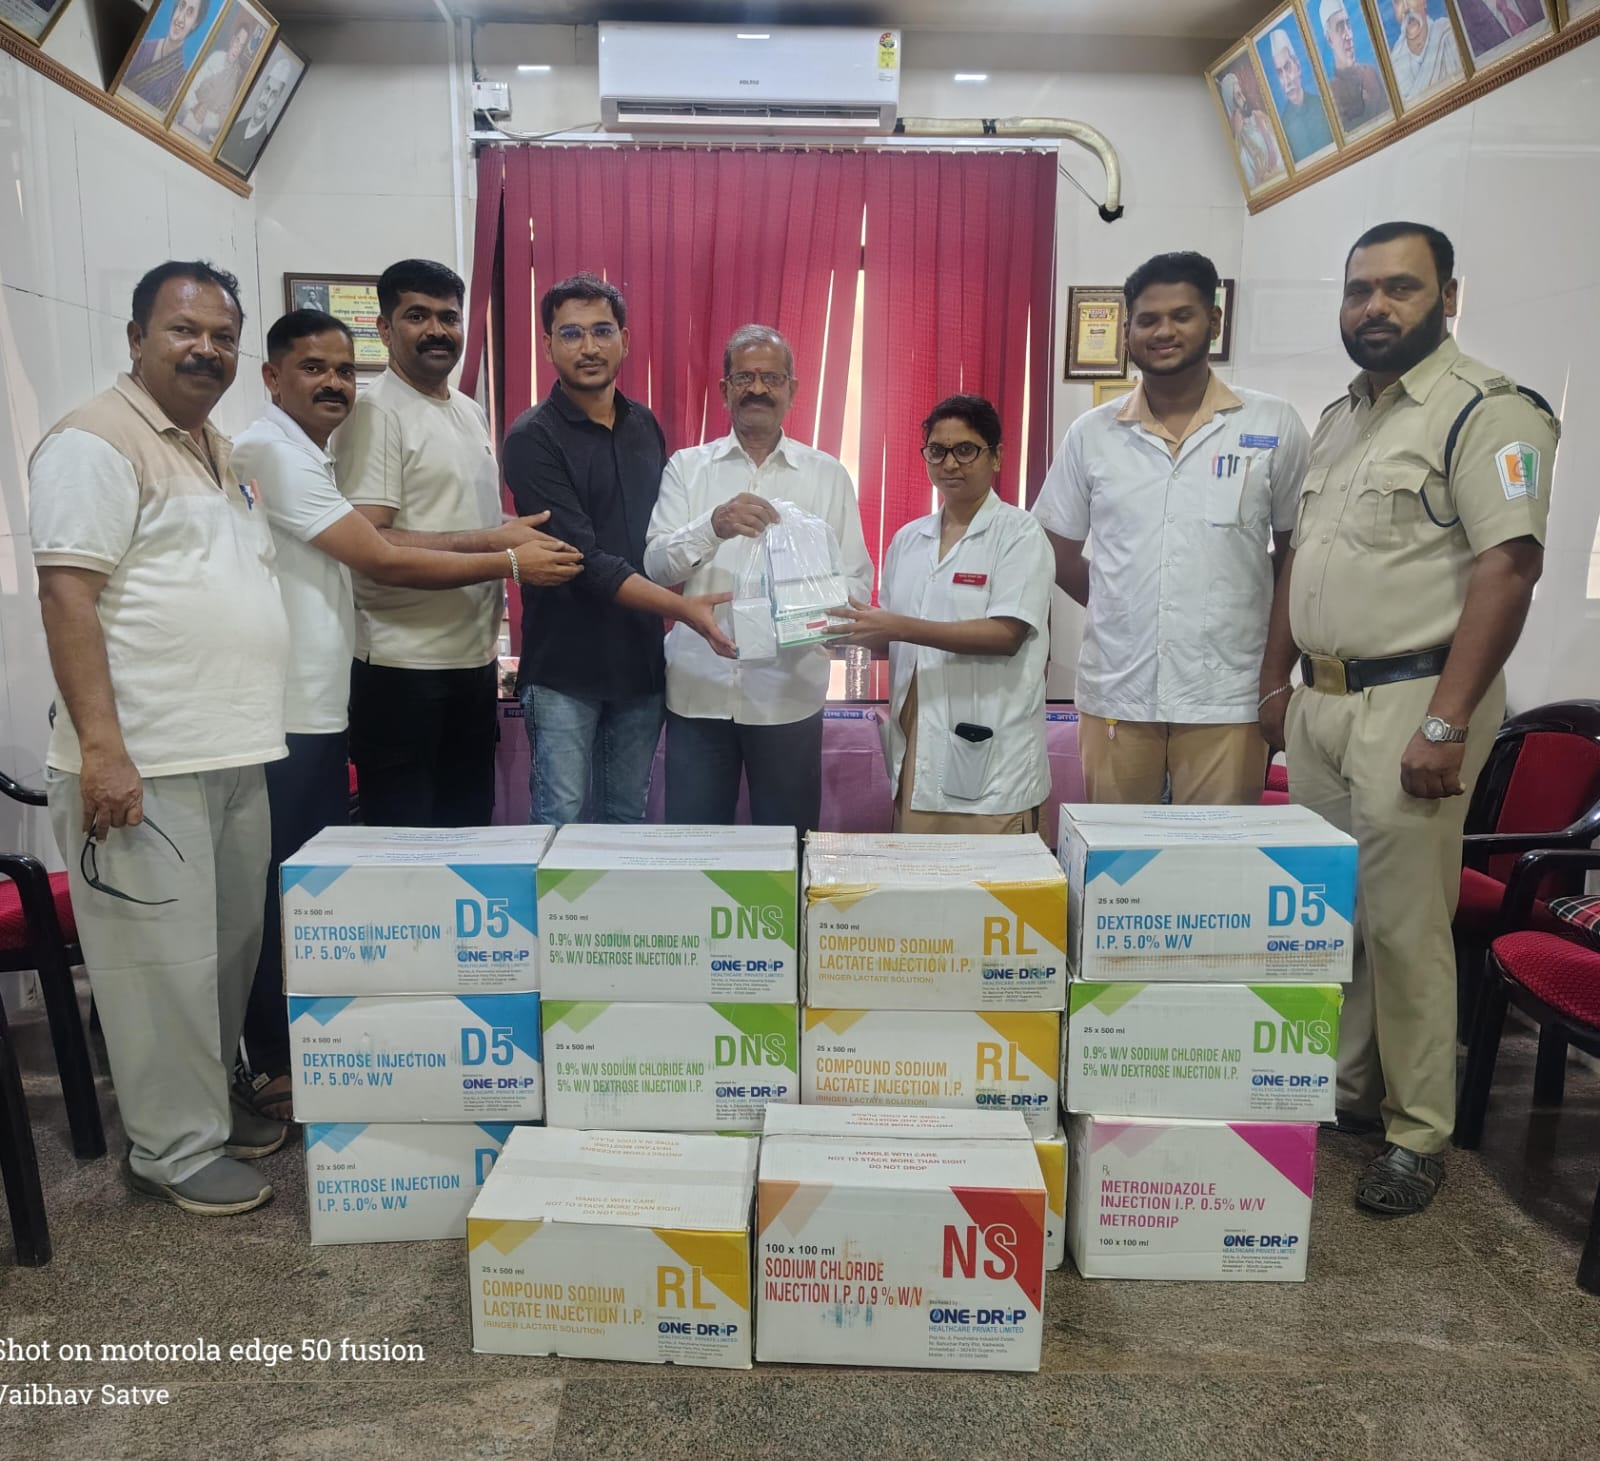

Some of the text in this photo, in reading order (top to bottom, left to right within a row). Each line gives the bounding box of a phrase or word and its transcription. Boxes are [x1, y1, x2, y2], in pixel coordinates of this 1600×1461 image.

[1268, 885, 1325, 927] D5
[456, 898, 510, 938] D5
[711, 905, 784, 940] DNS
[1097, 914, 1250, 930] DEXTROSE INJECTION
[295, 925, 440, 941] DEXTROSE INJECTION
[550, 933, 699, 948] 0.9% W/V SODIUM CHLORIDE AND
[983, 916, 1038, 956] RL
[1097, 934, 1193, 949] I.P. 5.0% W/V
[296, 945, 386, 960] I.P. 5.0% W/V
[819, 936, 954, 954] COMPOUND SODIUM
[550, 951, 698, 966] 5% W/V DEXTROSE INJECTION I.P.
[819, 955, 971, 973] LACTATE INJECTION I.P.
[461, 1027, 514, 1066] D5
[1254, 1020, 1331, 1056] DNS
[715, 1033, 786, 1067] DNS
[1084, 1047, 1241, 1062] 0.9% W/V SODIUM CHLORIDE AND
[303, 1053, 446, 1067] DEXTROSE INJECTION
[817, 1058, 947, 1077] COMPOUND SODIUM
[977, 1042, 1029, 1081] RL
[557, 1063, 704, 1076] 0.9% W/V SODIUM CHLORIDE AND
[1083, 1064, 1239, 1080] 5% W/V DEXTROSE INJECTION I.P.
[304, 1072, 393, 1087] I.P. 5.0% W/V
[558, 1079, 703, 1093] 5% W/V DEXTROSE INJECTION I.P.
[816, 1077, 964, 1097] LACTATE INJECTION I.P.
[318, 1175, 460, 1194] DEXTROSE INJECTION
[1102, 1180, 1216, 1196] METRONIDAZOLE
[318, 1195, 408, 1212] I.P. 5.0% W/V
[1101, 1196, 1266, 1211] INJECTION I.P. 0.5% W/V
[1100, 1215, 1179, 1228] METRODRIP
[766, 1243, 835, 1256] 100 x 100 ml
[943, 1223, 1018, 1281] NS
[1123, 1239, 1136, 1247] 100
[766, 1258, 884, 1282] SODIUM CHLORIDE
[483, 1280, 625, 1304] COMPOUND SODIUM
[657, 1266, 716, 1310] RL
[765, 1282, 829, 1303] INJECTION
[834, 1285, 853, 1305] I.P.
[898, 1287, 923, 1306] W/V
[484, 1302, 645, 1326] LACTATE INJECTION I.P.
